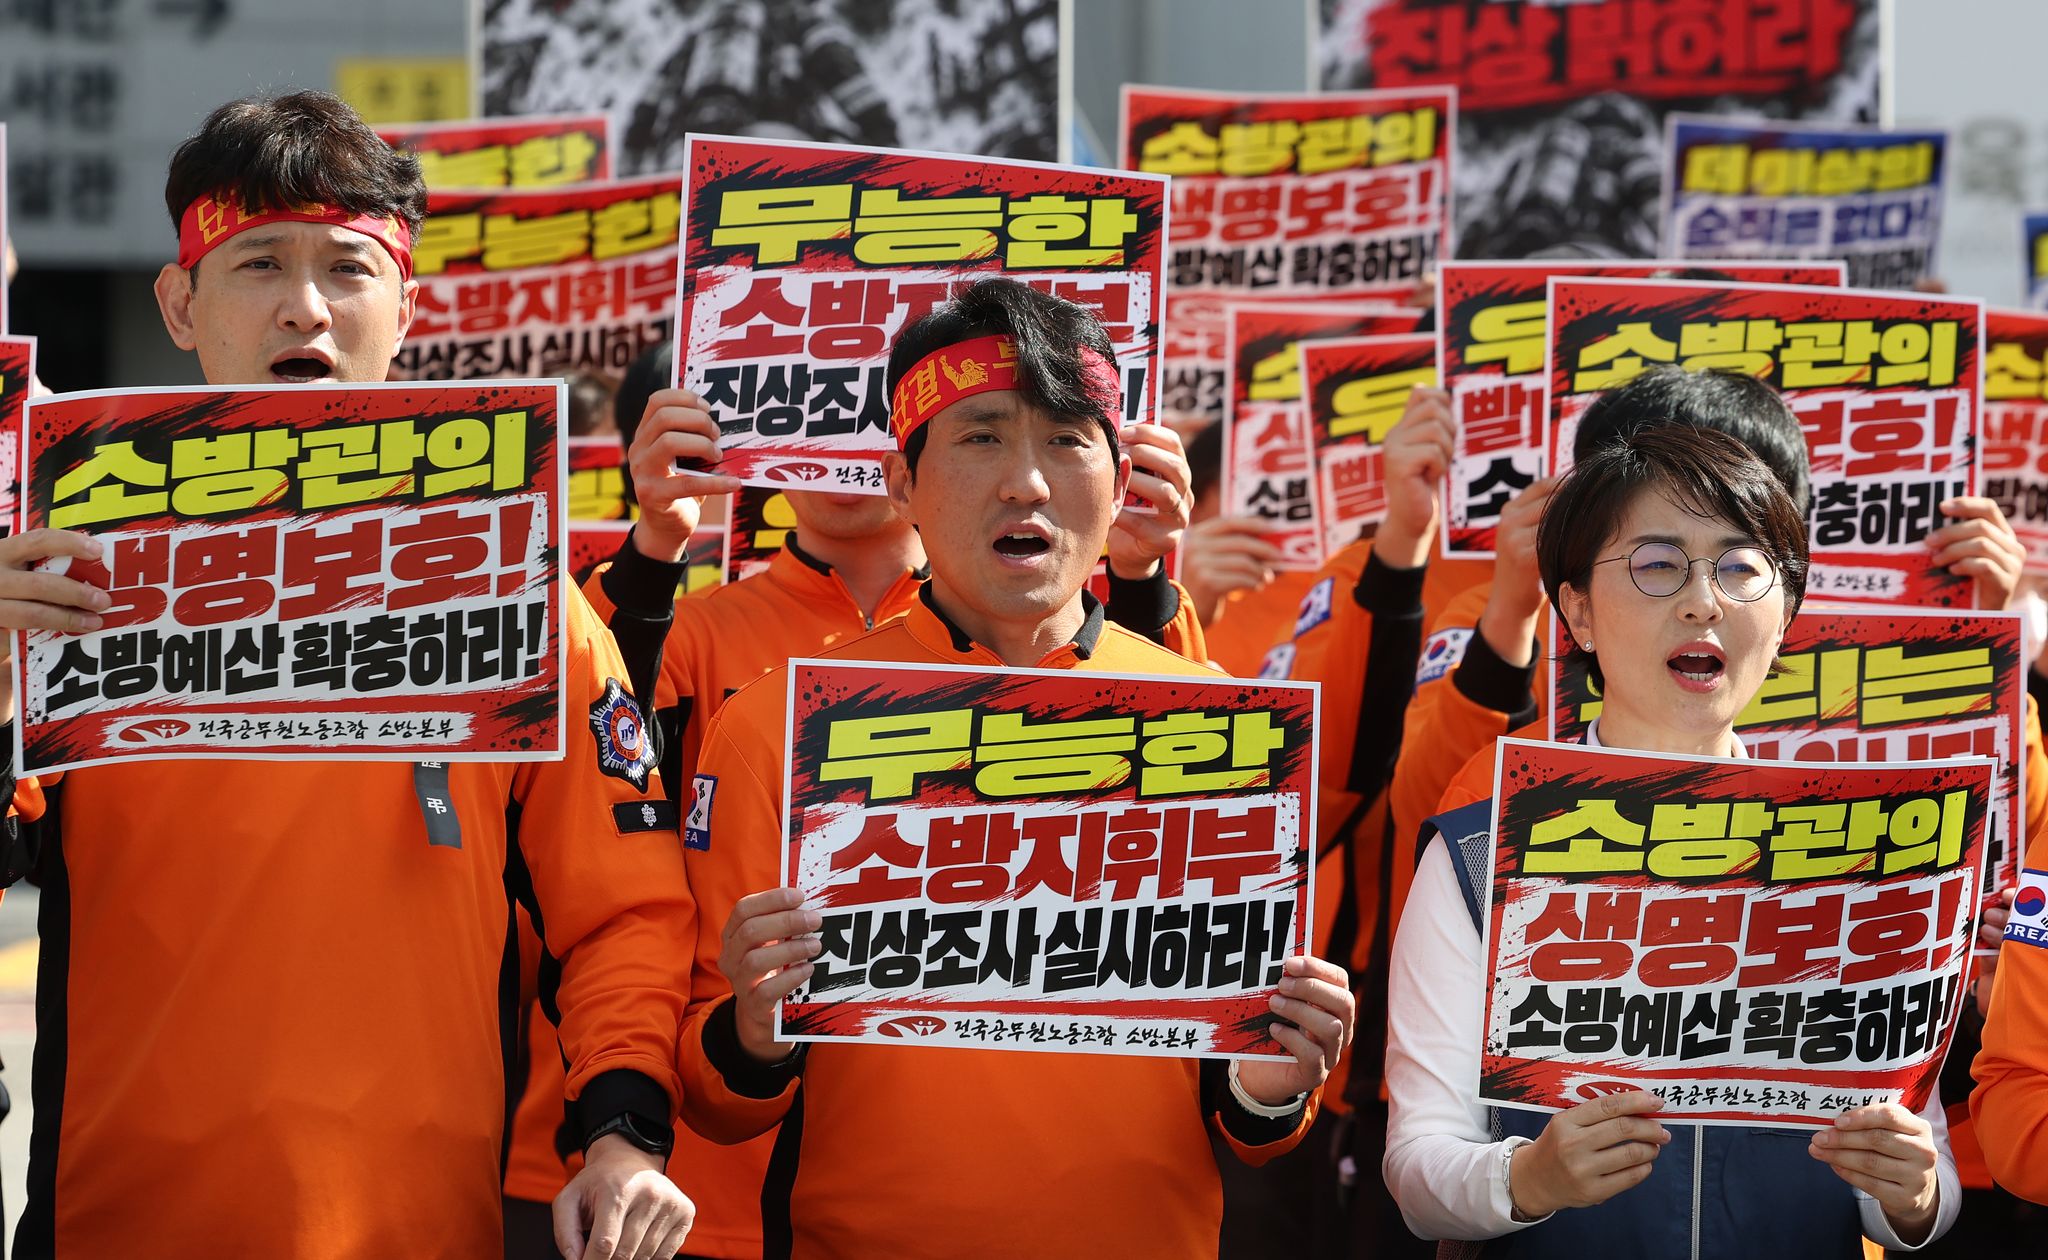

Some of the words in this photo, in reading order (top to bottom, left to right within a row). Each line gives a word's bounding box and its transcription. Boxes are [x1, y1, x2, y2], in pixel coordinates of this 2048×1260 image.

[405, 131, 597, 188] 능한
[1139, 106, 1438, 176] 소방관의
[711, 183, 1138, 269] 무능한
[1168, 243, 1285, 288] 방예산
[1573, 319, 1959, 392] 소방관의
[48, 411, 527, 529] 소방관의
[1808, 481, 1965, 547] 충하라!
[45, 621, 285, 714] 소방예산
[292, 602, 546, 692] 확충하라!
[198, 718, 369, 740] 전국공무원노동조합
[378, 718, 455, 739] 소방본부
[620, 723, 636, 742] 119
[819, 708, 1285, 800] 무능한
[814, 807, 1282, 906] 소방지휘부
[1522, 790, 1968, 880] 소방관의
[808, 906, 1042, 994] 진상조사
[1043, 900, 1295, 993] 실시하라!
[1524, 877, 1965, 989] 생명보호!
[2003, 924, 2048, 943] OREA
[954, 1018, 1117, 1046] 전국공무원노동조합
[1125, 1026, 1199, 1050] 소방본부
[1507, 985, 1741, 1062] 소방예산
[1742, 974, 1960, 1064] 확충하라!
